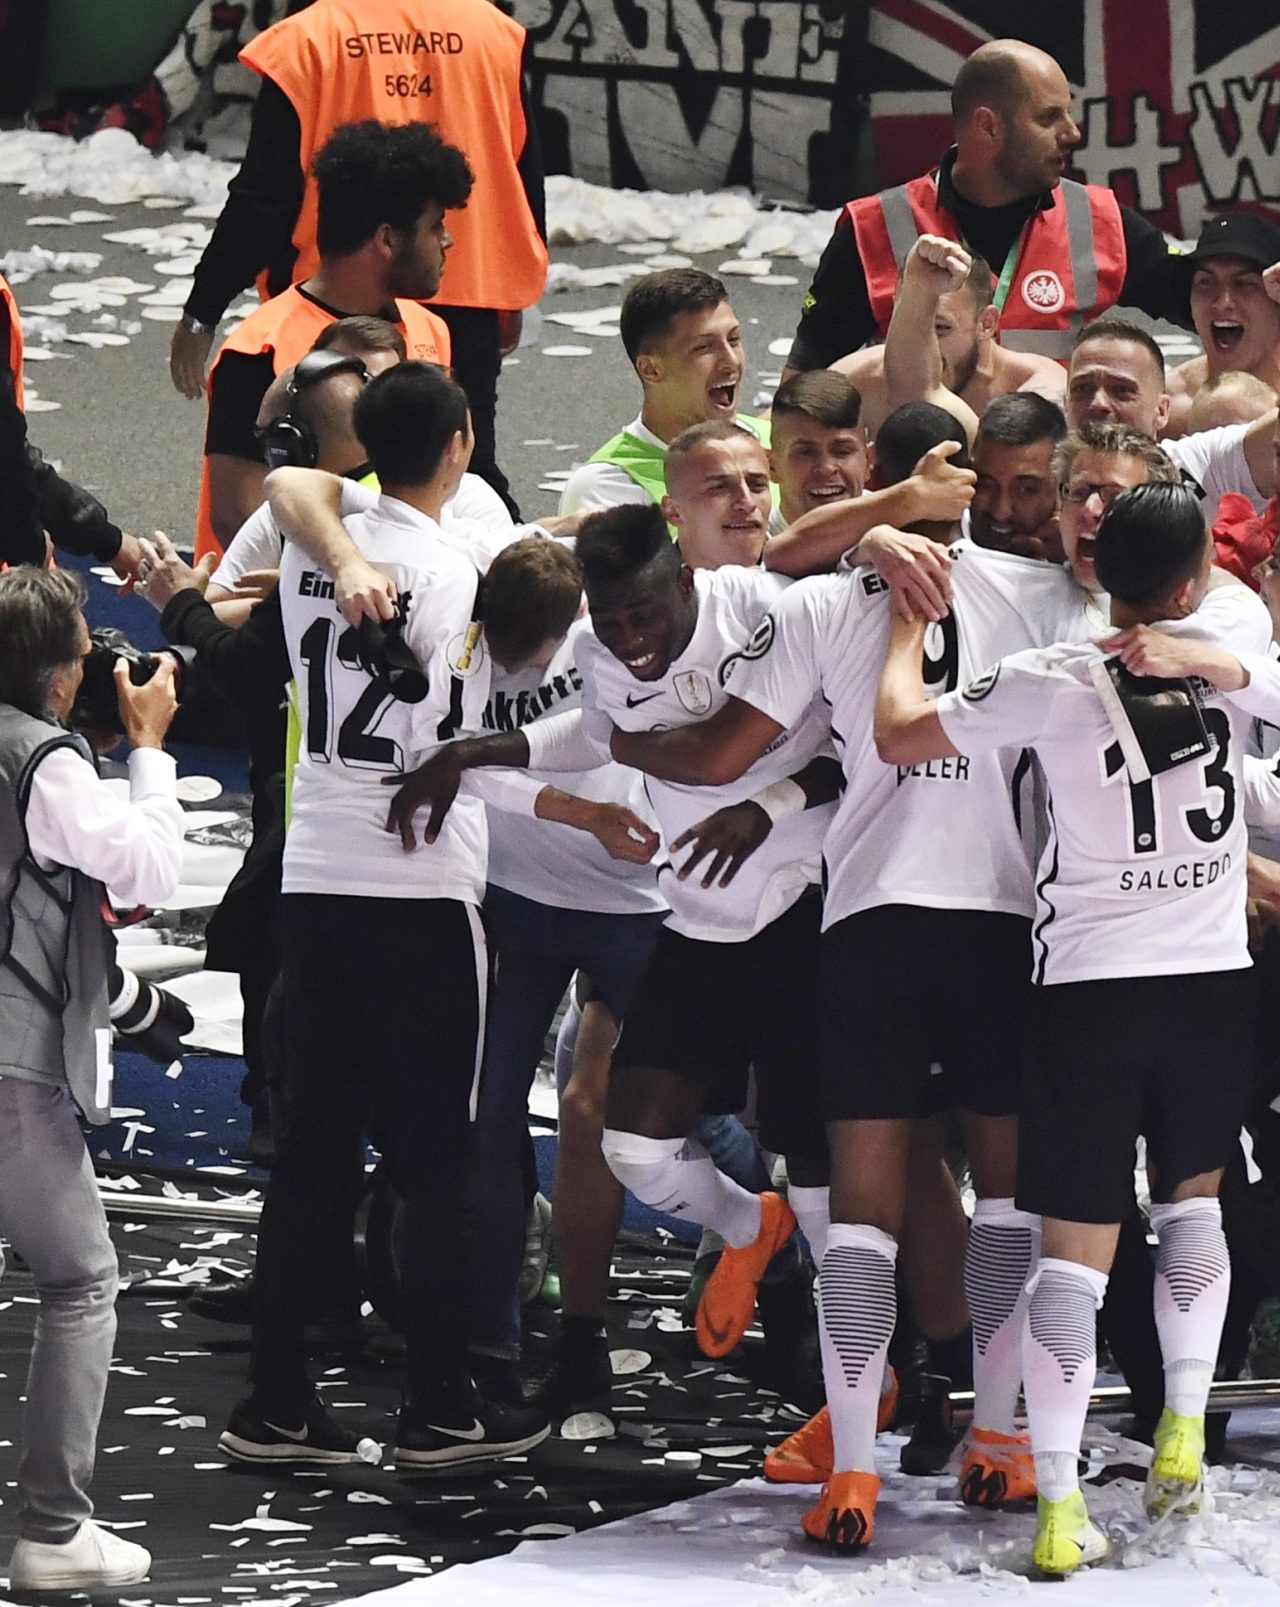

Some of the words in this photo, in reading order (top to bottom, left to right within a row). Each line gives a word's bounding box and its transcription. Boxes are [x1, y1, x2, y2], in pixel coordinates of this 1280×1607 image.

[346, 32, 463, 58] STEWARD
[385, 74, 432, 98] 5624
[301, 616, 404, 773] 12
[1104, 707, 1236, 854] 13
